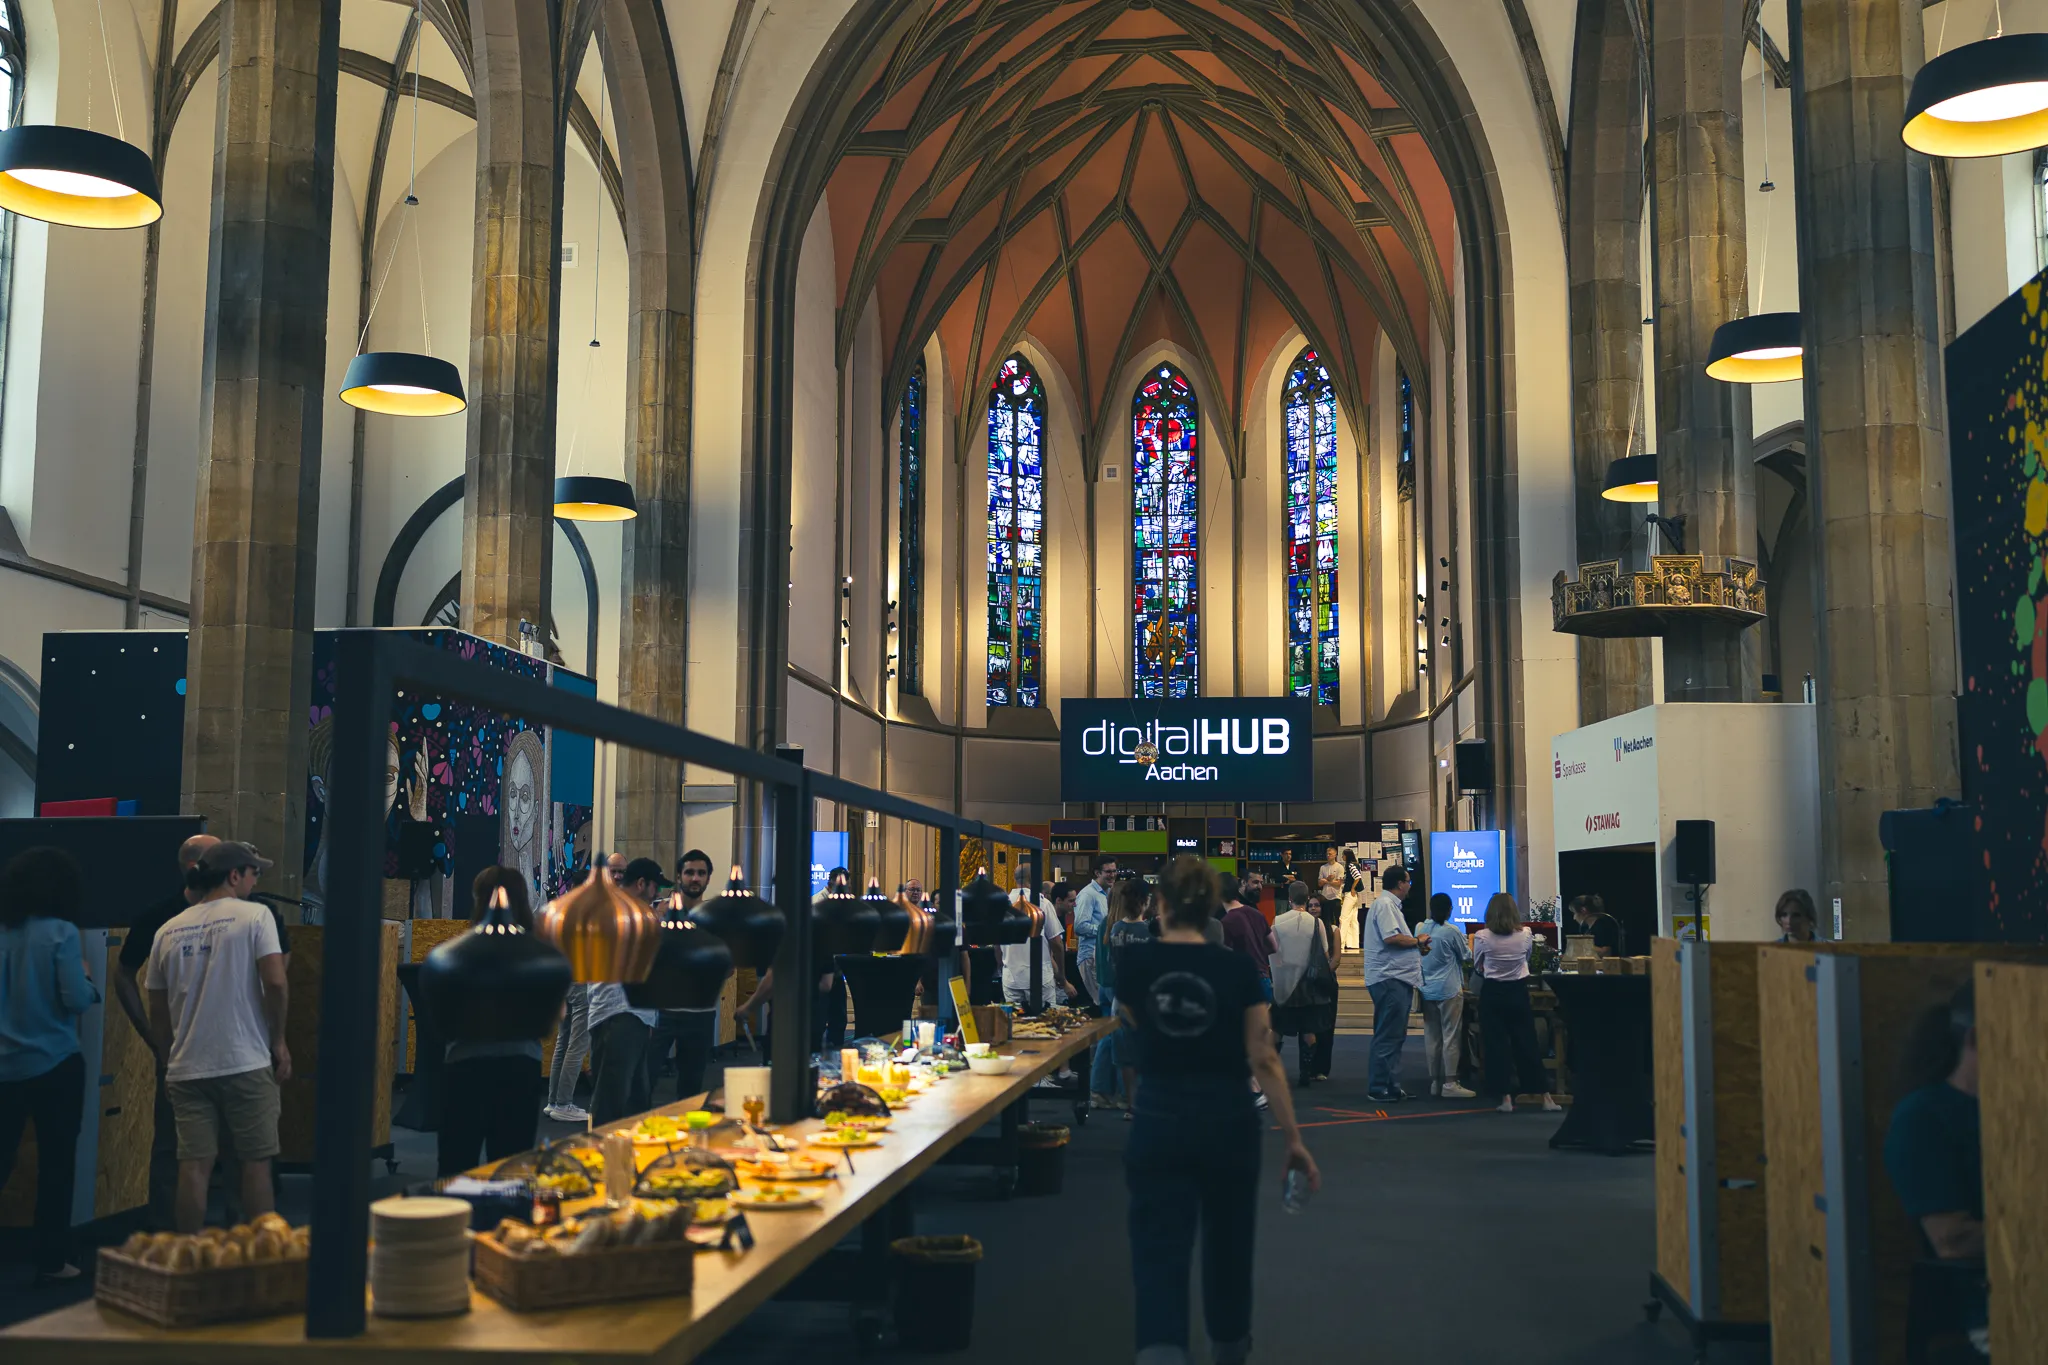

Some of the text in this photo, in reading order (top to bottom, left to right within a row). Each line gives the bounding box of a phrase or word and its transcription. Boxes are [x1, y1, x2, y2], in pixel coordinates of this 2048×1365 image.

[1082, 718, 1290, 764] digitalHUB
[1623, 736, 1653, 753] NetAachen
[1145, 763, 1218, 780] Aachen
[1562, 761, 1586, 779] Sparkasse
[1593, 811, 1620, 831] STAWAG
[1446, 859, 1485, 870] digitalHUB
